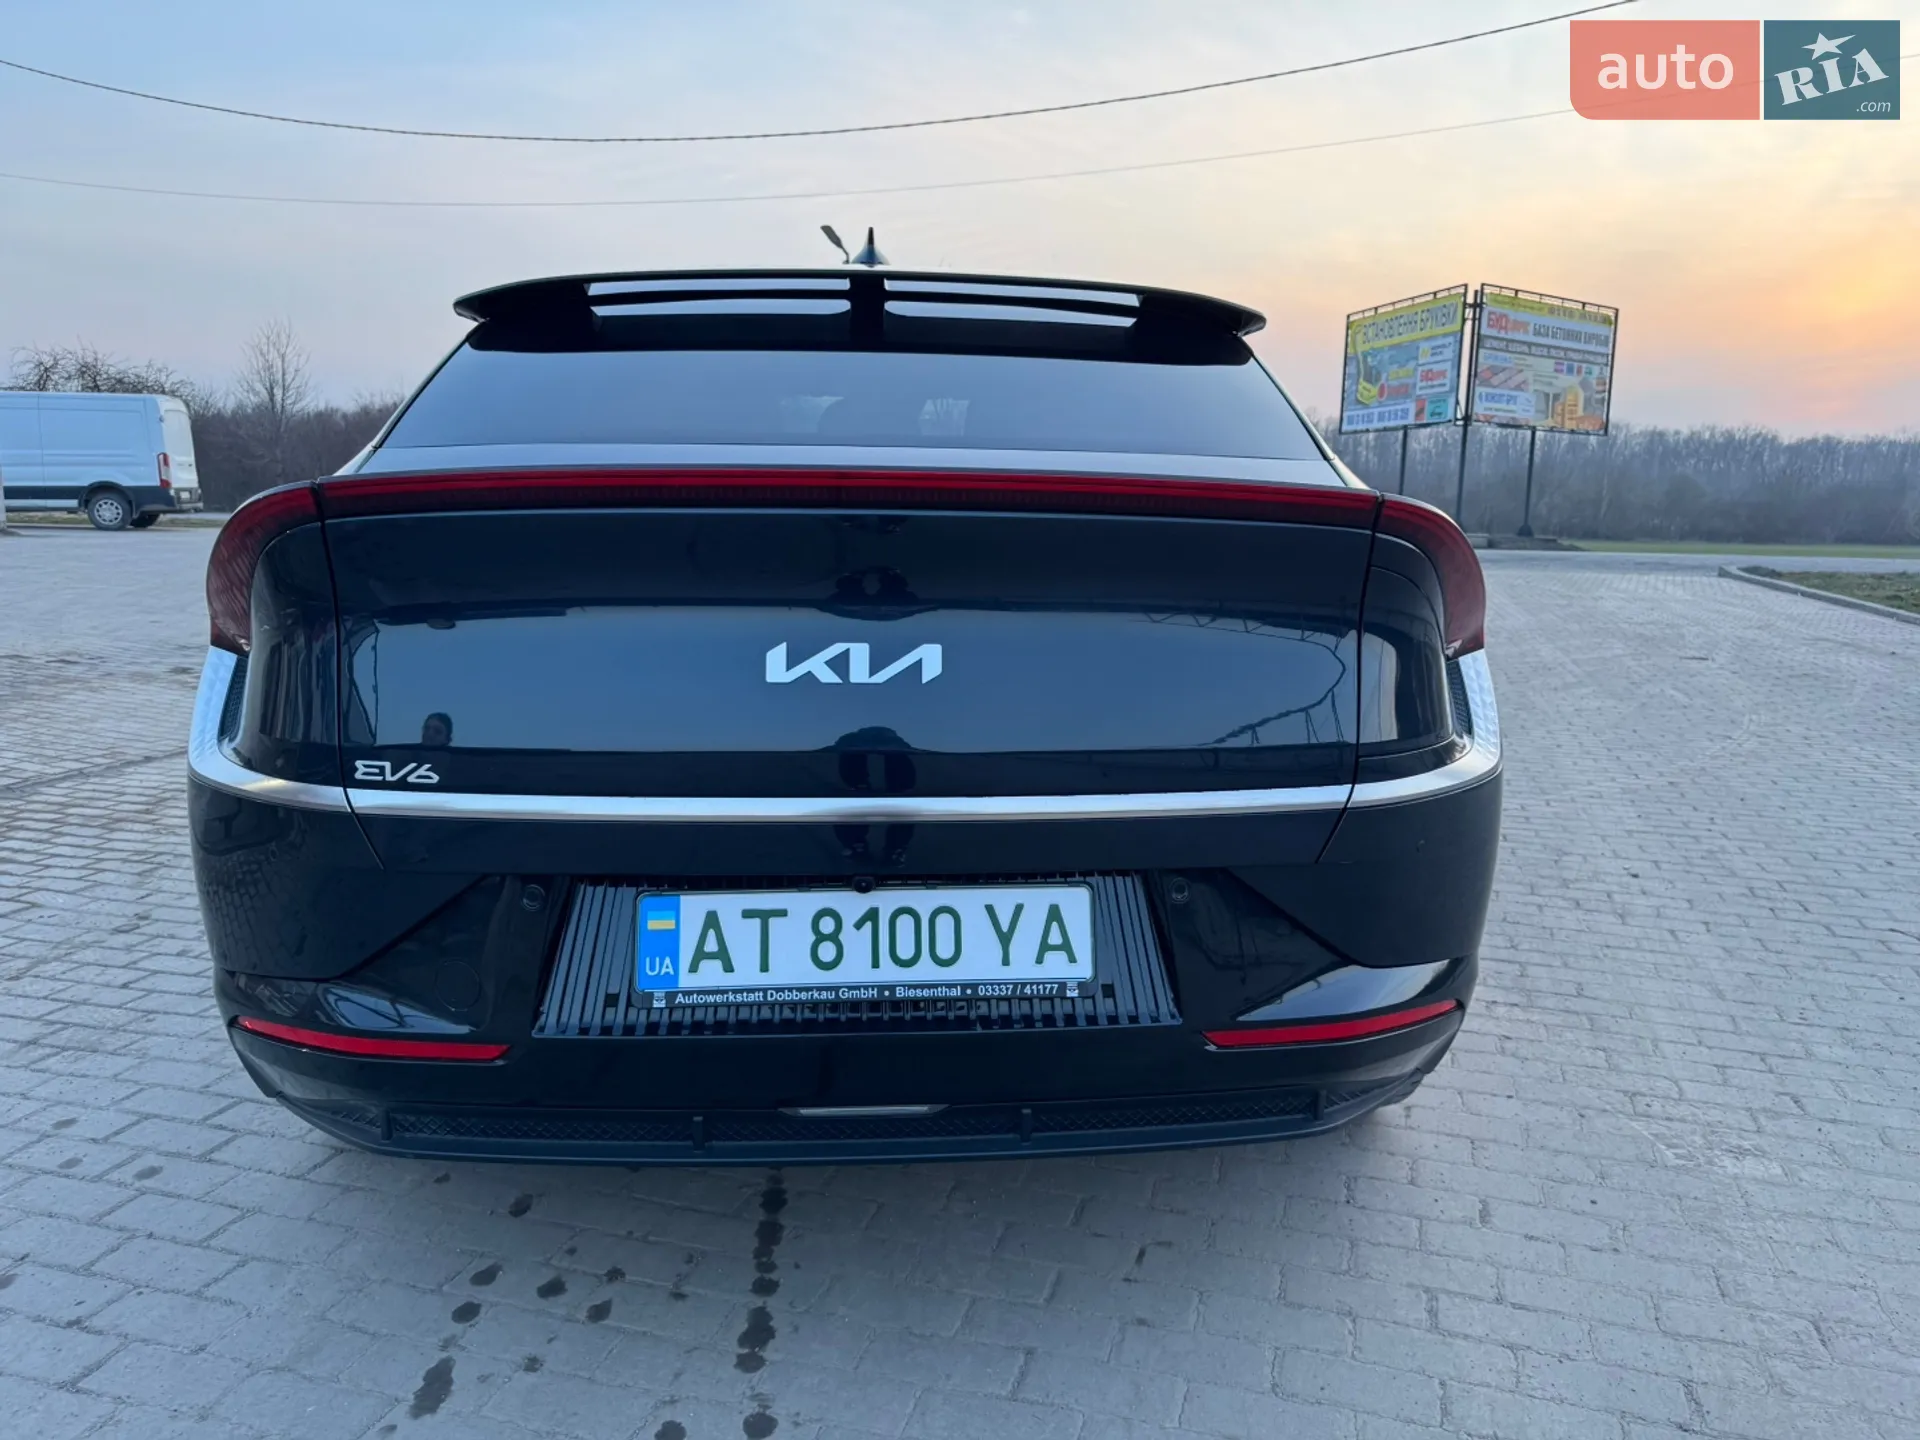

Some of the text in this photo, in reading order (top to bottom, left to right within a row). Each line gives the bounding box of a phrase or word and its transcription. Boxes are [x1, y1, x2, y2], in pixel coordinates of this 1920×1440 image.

[766, 641, 943, 685] KIA
[354, 759, 441, 784] EV6
[687, 902, 1079, 974] AT 8100 YA
[645, 955, 675, 977] UA
[674, 989, 764, 1004] Autowerkstatt
[767, 988, 835, 1001] Dobberkau
[838, 986, 878, 999] GmbH
[895, 985, 961, 998] Biesenthal
[978, 984, 1012, 996] 03337
[1024, 983, 1059, 995] 41177
